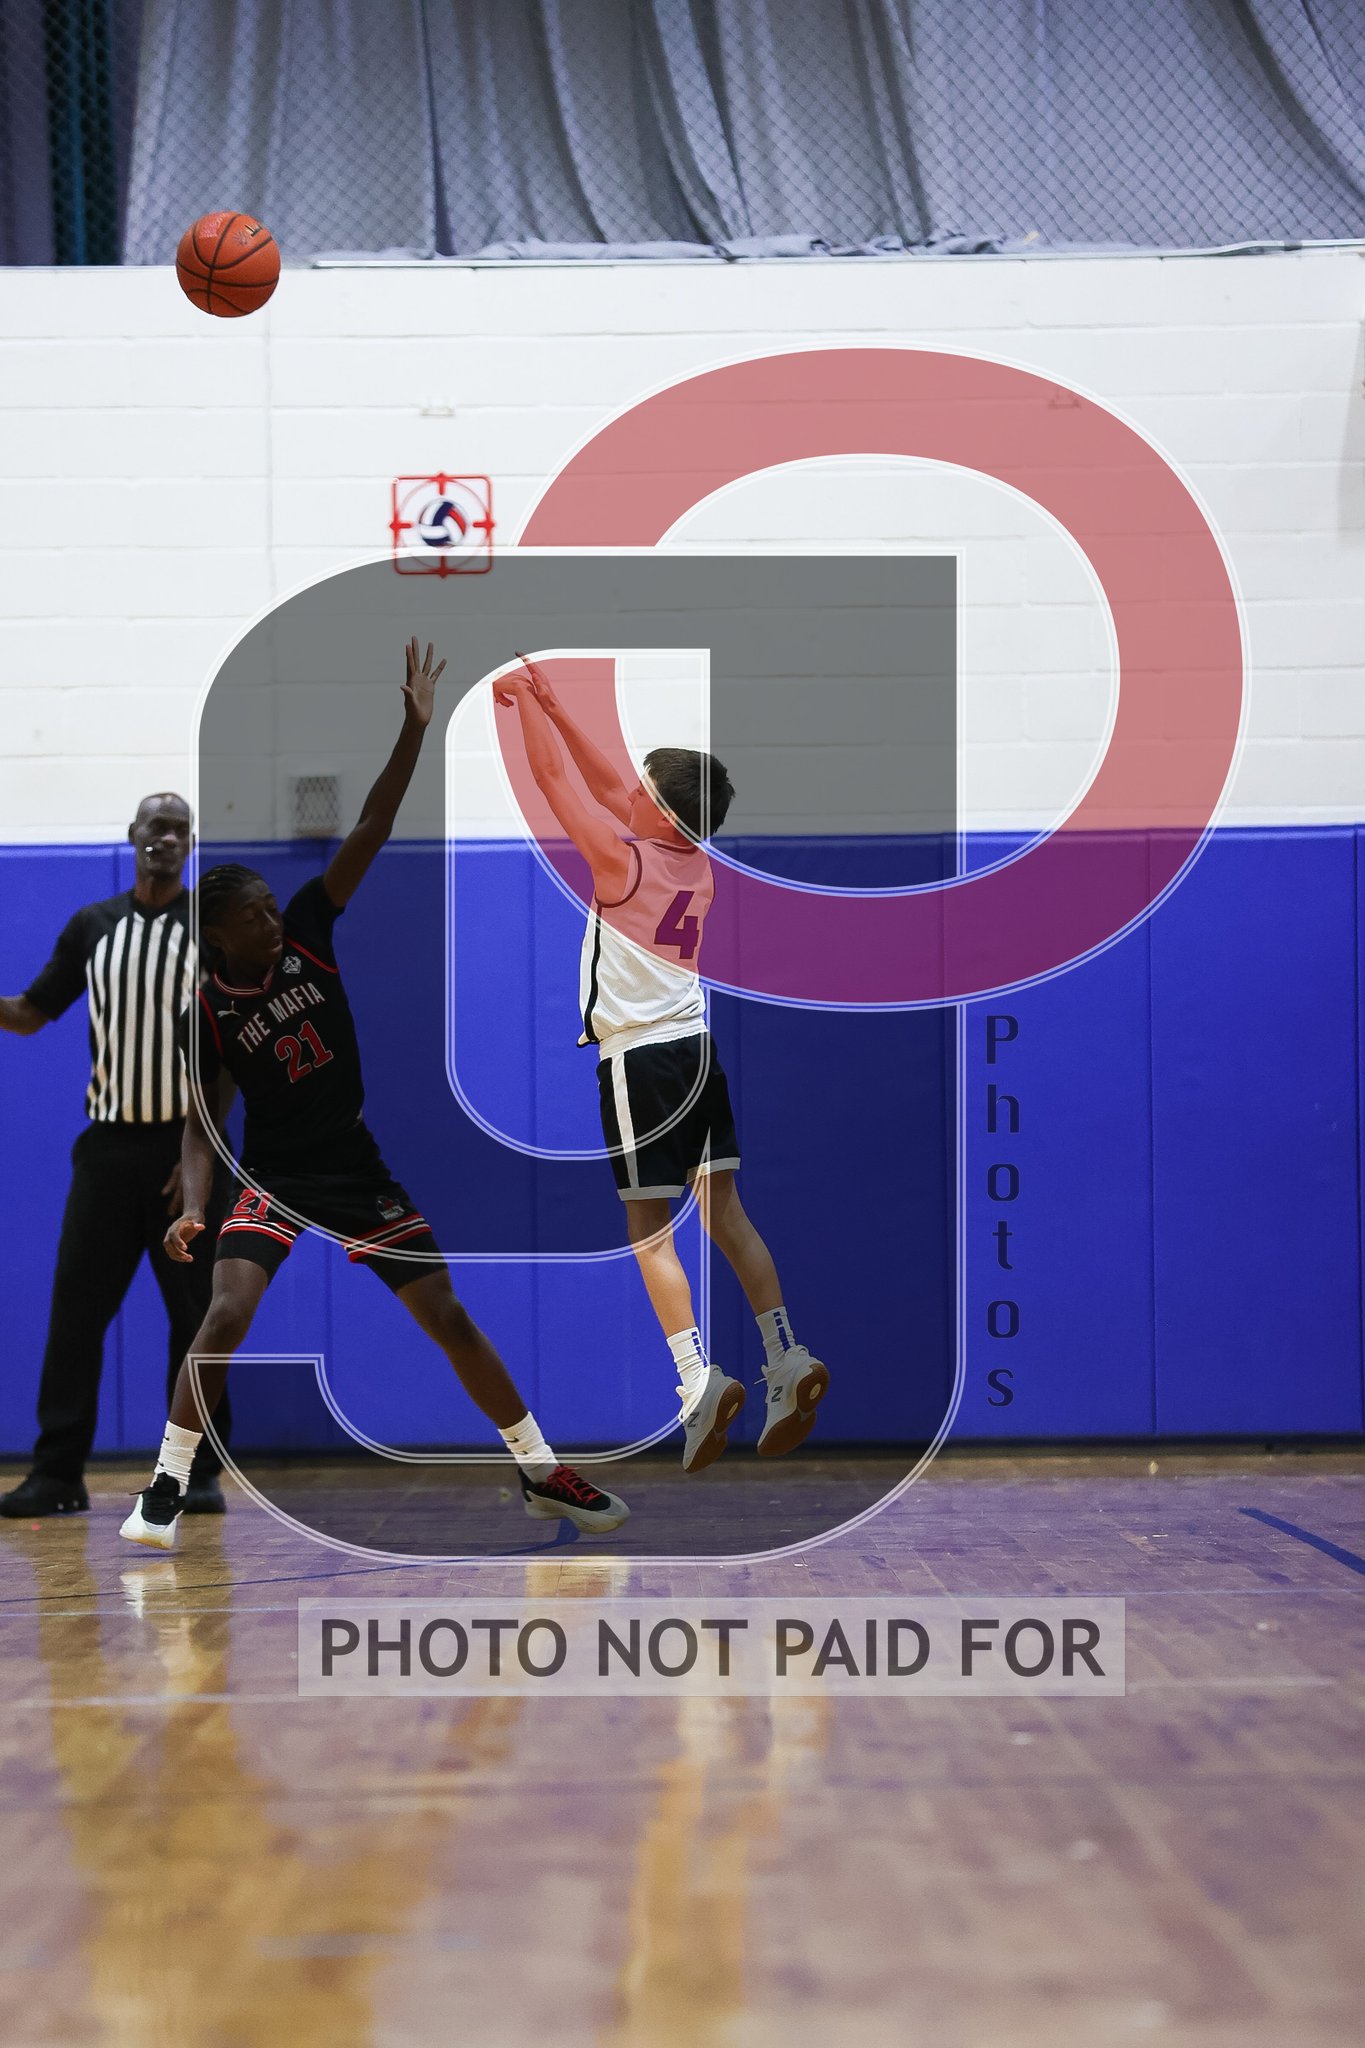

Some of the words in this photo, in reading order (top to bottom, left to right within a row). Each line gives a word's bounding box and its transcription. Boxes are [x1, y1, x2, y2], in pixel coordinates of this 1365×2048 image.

[653, 890, 700, 960] 4
[237, 1012, 271, 1053] THE
[267, 982, 326, 1023] MAFIA
[274, 1020, 334, 1084] 21
[233, 1188, 274, 1220] 21
